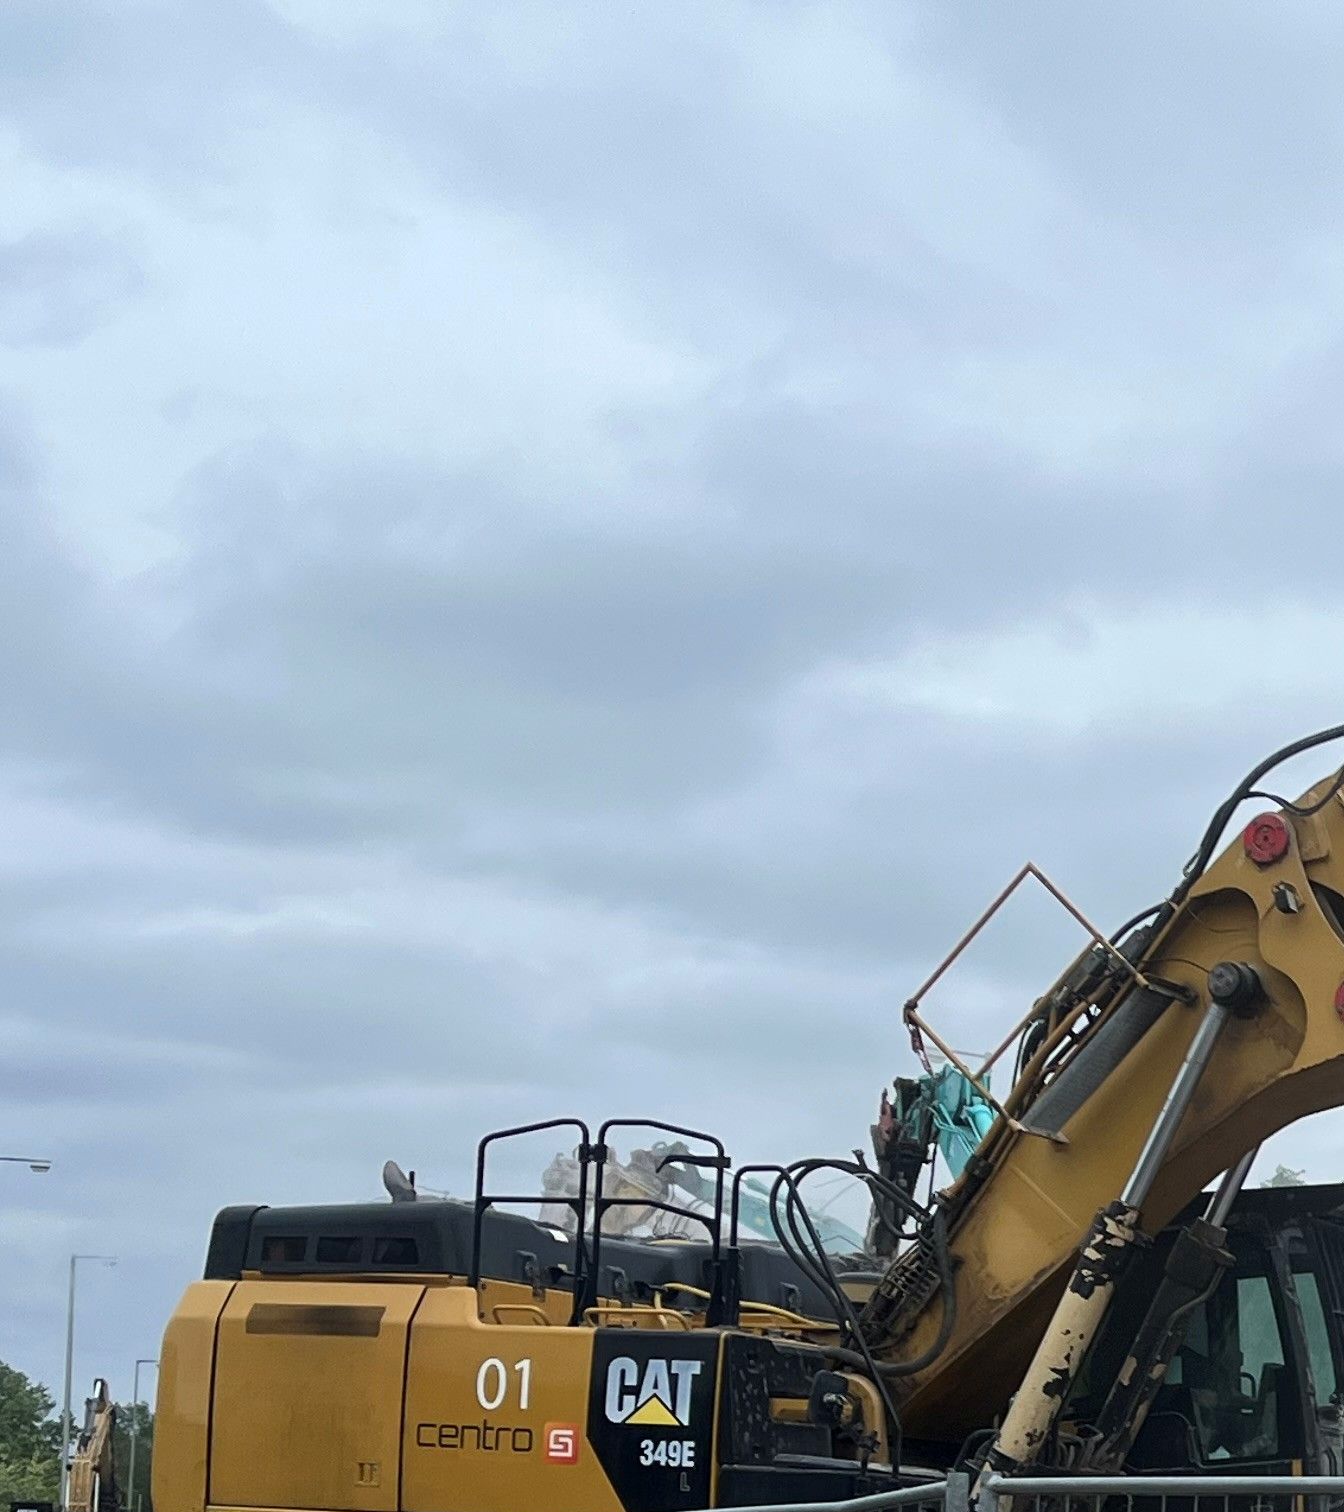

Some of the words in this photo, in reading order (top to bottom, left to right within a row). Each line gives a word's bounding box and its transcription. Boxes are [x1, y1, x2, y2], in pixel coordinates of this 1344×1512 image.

[476, 1357, 533, 1411] 01
[605, 1356, 702, 1426] CAT
[416, 1419, 533, 1452] centro
[639, 1440, 696, 1468] 349E
